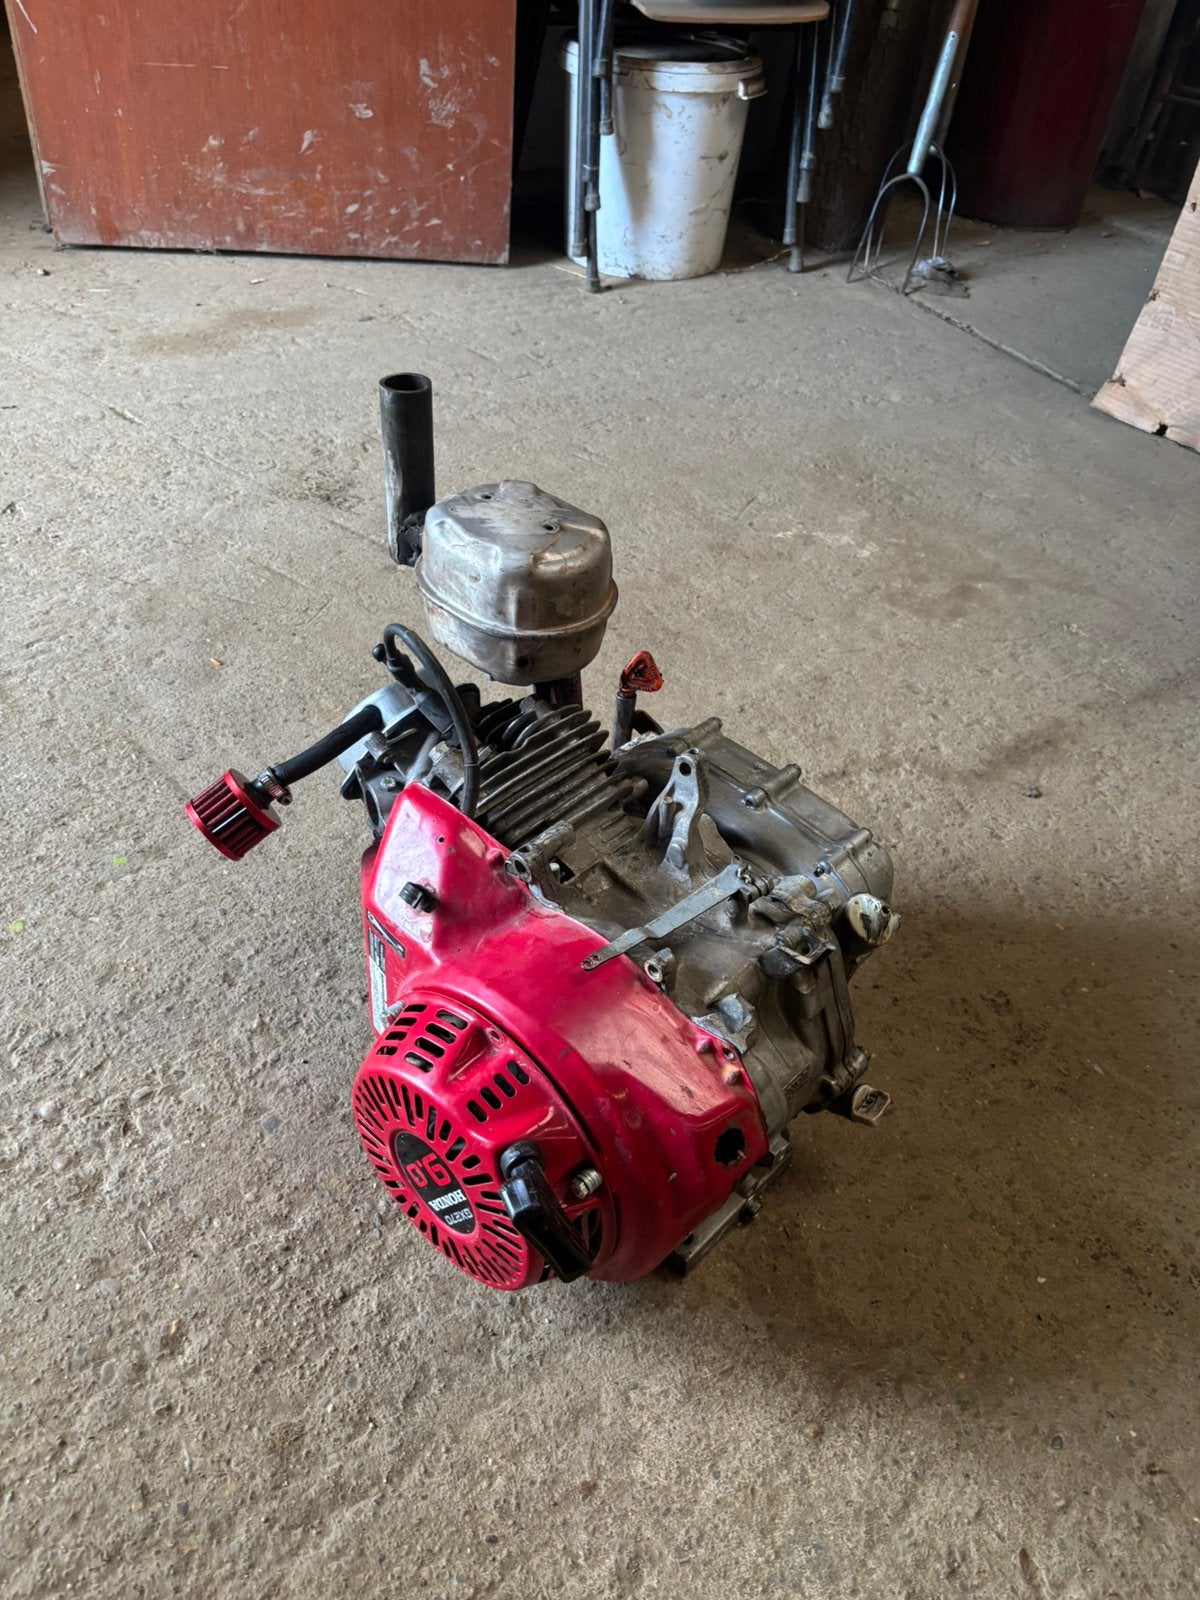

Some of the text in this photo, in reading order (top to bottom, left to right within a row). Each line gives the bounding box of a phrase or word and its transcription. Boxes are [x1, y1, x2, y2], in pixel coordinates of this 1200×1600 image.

[406, 1152, 451, 1188] 9.0
[428, 1189, 467, 1211] HONDA
[444, 1207, 474, 1226] GX270
